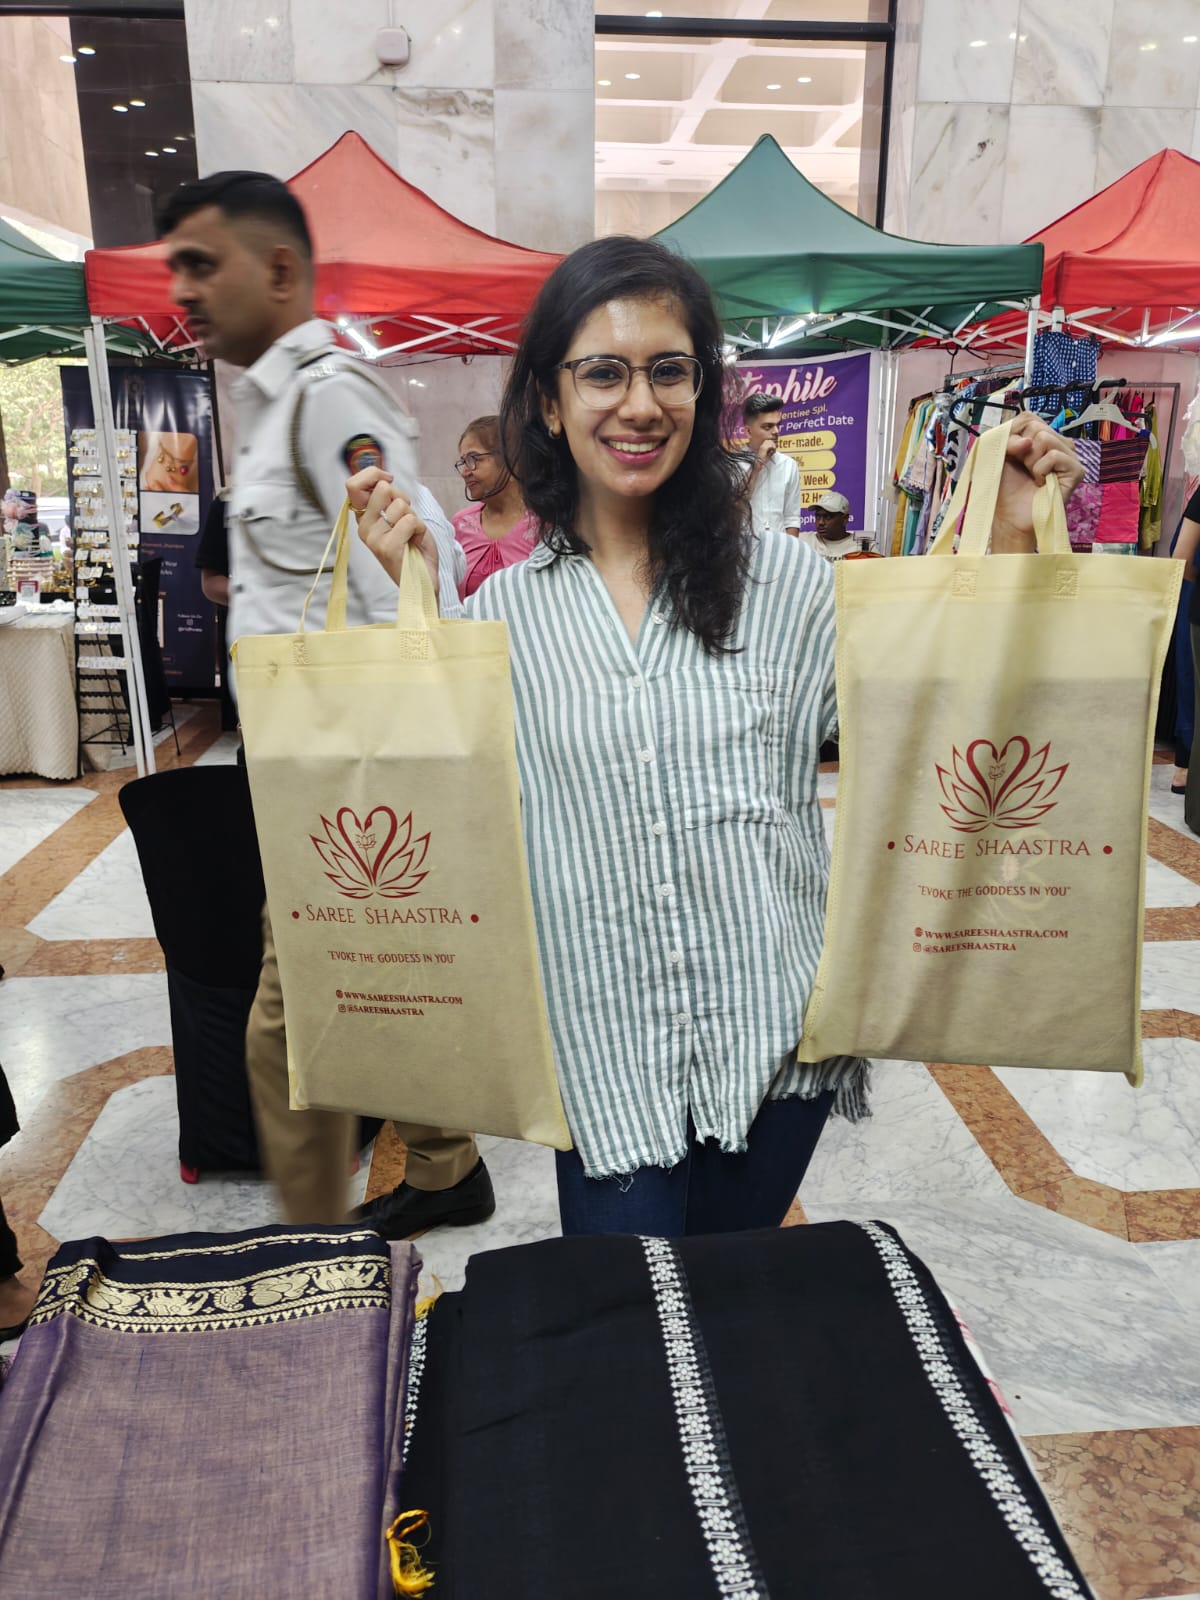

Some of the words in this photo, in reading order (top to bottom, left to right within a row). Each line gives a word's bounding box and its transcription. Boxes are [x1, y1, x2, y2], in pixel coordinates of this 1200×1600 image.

[786, 416, 825, 431] Perfect
[828, 415, 854, 426] Date
[803, 473, 829, 486] Week
[802, 493, 810, 503] 12
[904, 834, 966, 859] SAREE
[976, 838, 1091, 857] SHAASTRA
[957, 888, 973, 898] THE
[975, 885, 1026, 896] GODDESS
[1030, 886, 1041, 896] IN
[306, 904, 356, 924] SAREE
[364, 906, 463, 925] SHAASTRA
[359, 953, 375, 963] THE
[378, 953, 421, 964] GODDESS
[423, 953, 433, 964] IN
